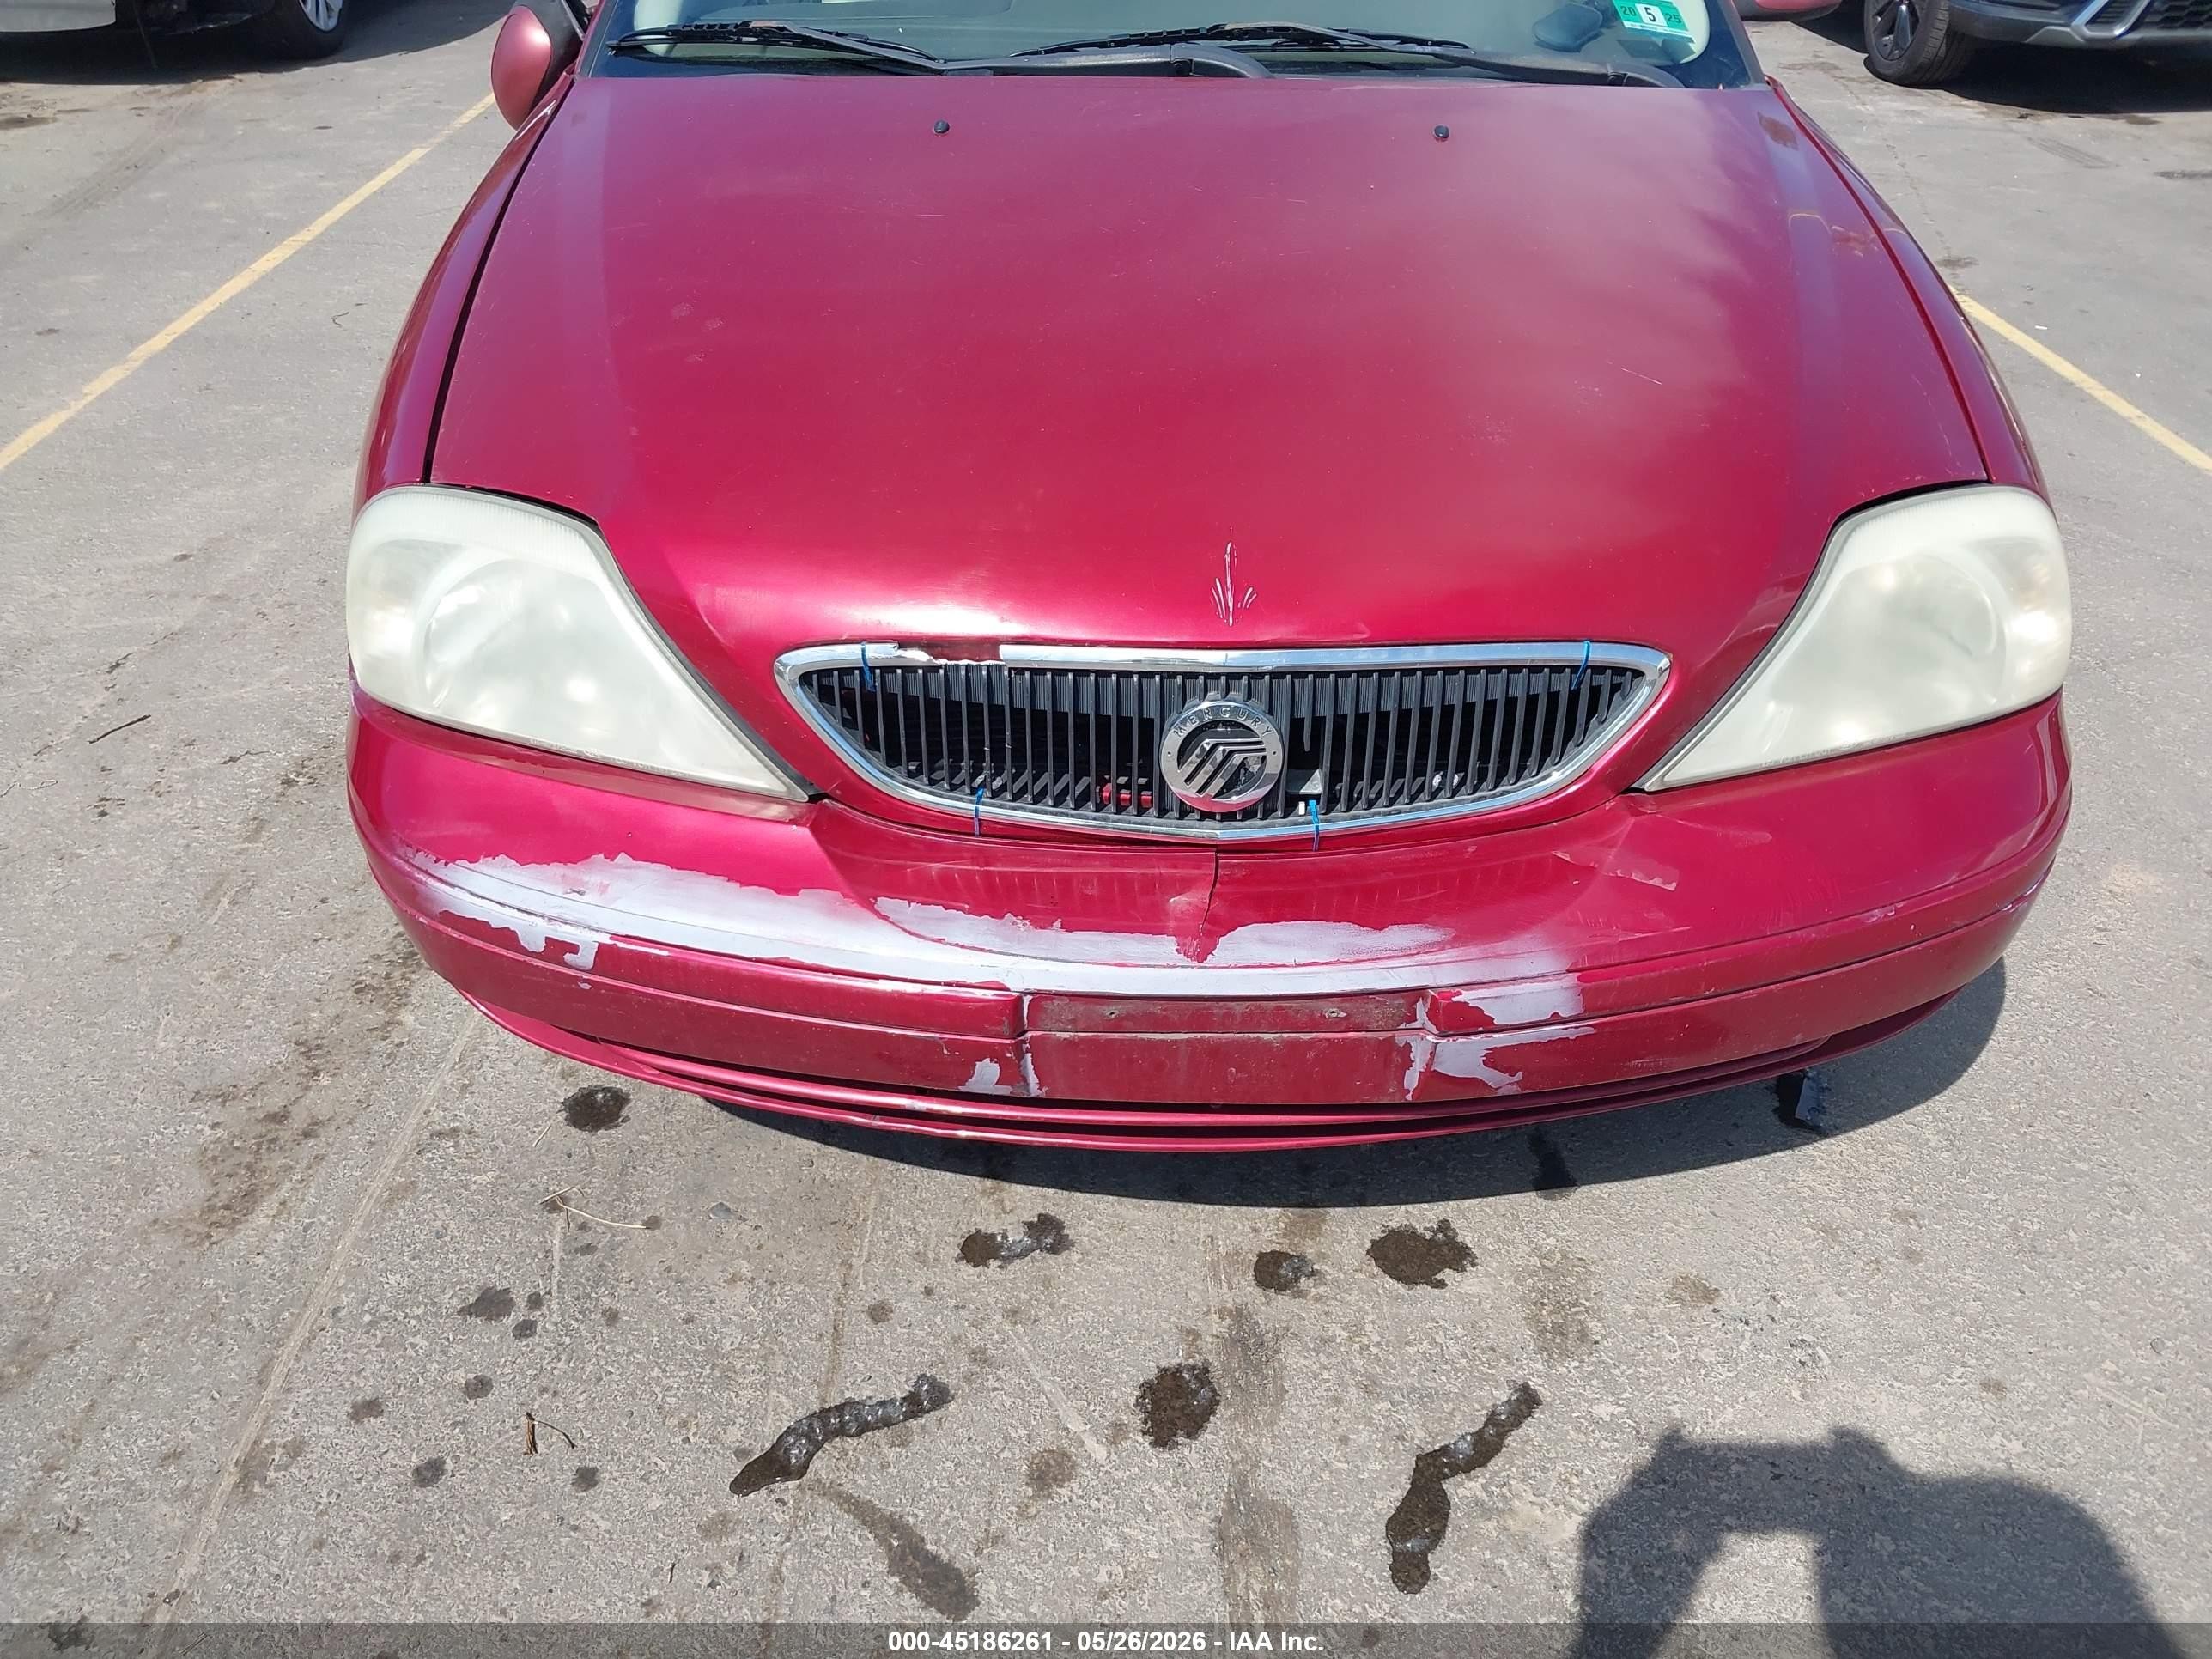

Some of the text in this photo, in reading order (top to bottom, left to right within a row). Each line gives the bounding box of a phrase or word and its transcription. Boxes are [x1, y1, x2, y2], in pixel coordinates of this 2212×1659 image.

[1620, 6, 1681, 23] 20 5 25
[1173, 707, 1273, 738] MERCURY
